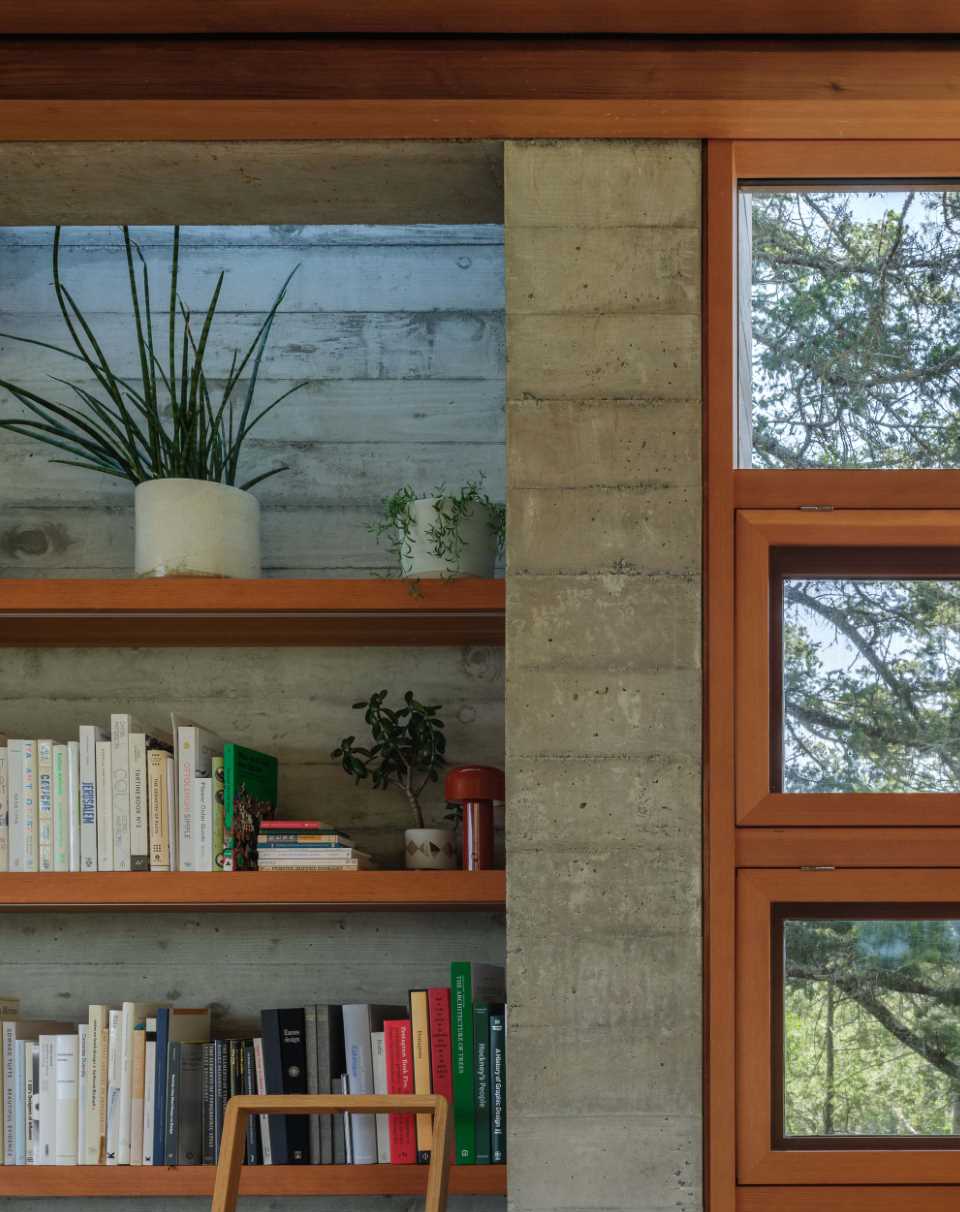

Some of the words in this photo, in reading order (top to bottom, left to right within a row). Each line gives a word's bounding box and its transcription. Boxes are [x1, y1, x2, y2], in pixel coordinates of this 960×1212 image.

[82, 782, 94, 824] JERUSALEM
[458, 1042, 463, 1052] OF
[477, 1043, 485, 1081] Hockney's
[477, 1082, 485, 1108] People
